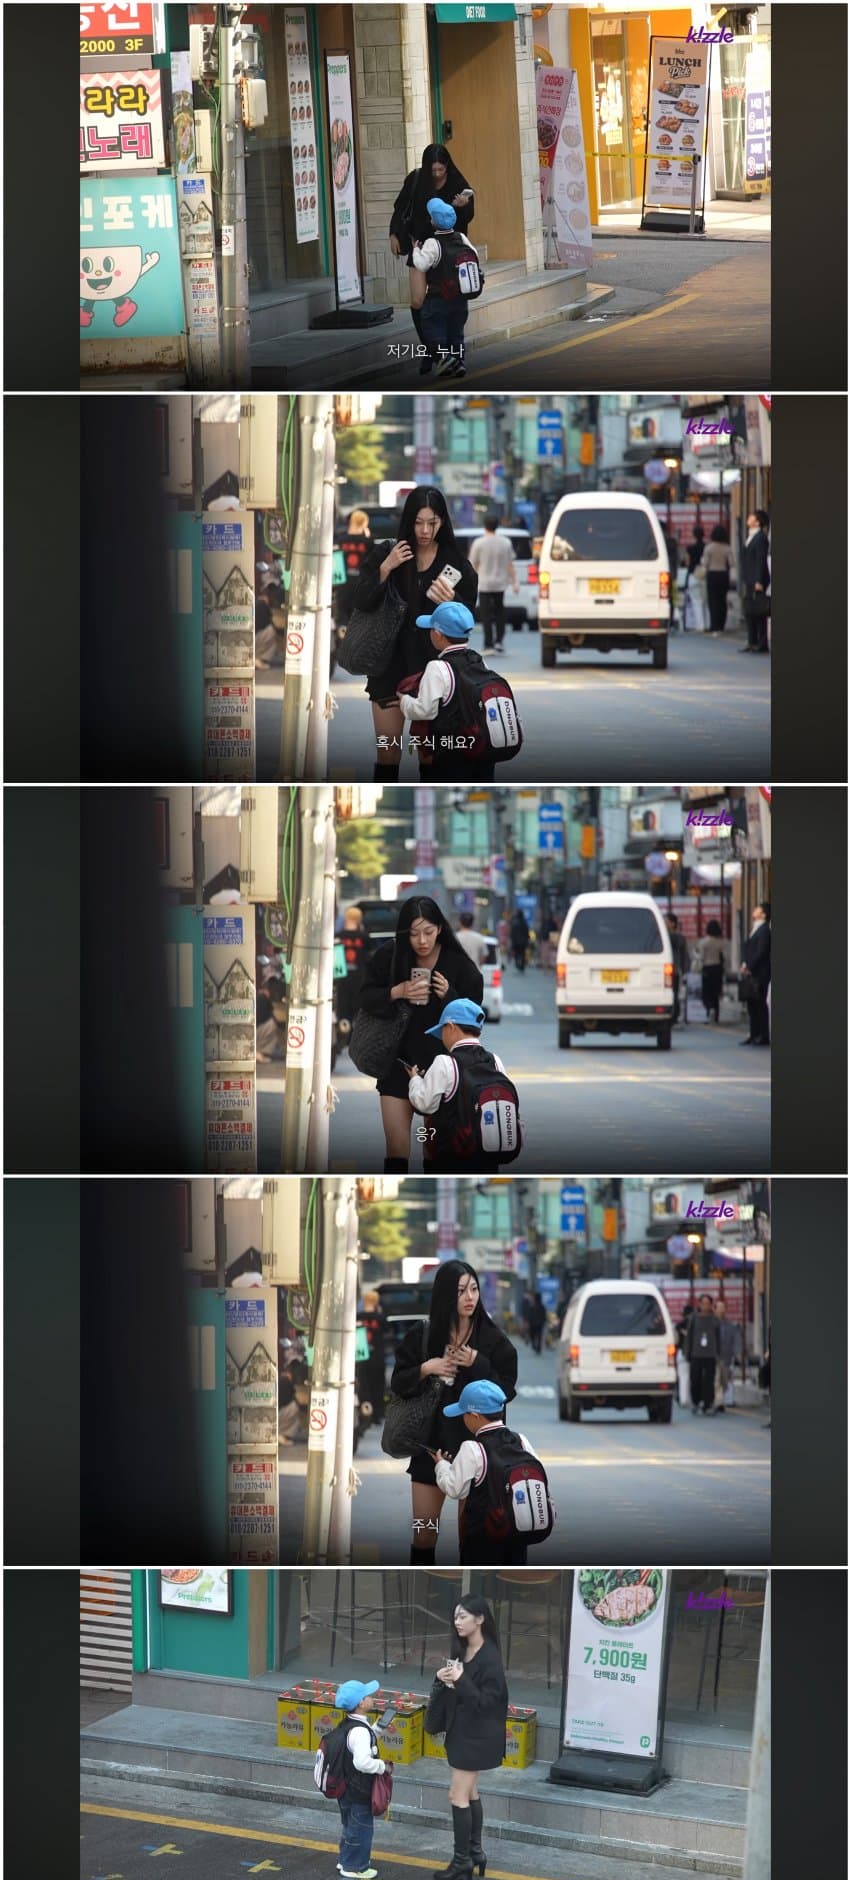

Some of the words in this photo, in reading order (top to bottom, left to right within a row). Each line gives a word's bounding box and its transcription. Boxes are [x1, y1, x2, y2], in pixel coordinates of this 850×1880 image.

[125, 39, 144, 51] 3F
[659, 56, 701, 67] LUNCH
[80, 122, 153, 162] 노래
[504, 700, 516, 741] DONGBUK
[505, 1104, 513, 1147] DONGBUK
[534, 1483, 544, 1525] DONGBUK
[583, 1646, 648, 1670] 7,900원
[594, 1670, 619, 1681] 단백질
[620, 1673, 636, 1683] 35g
